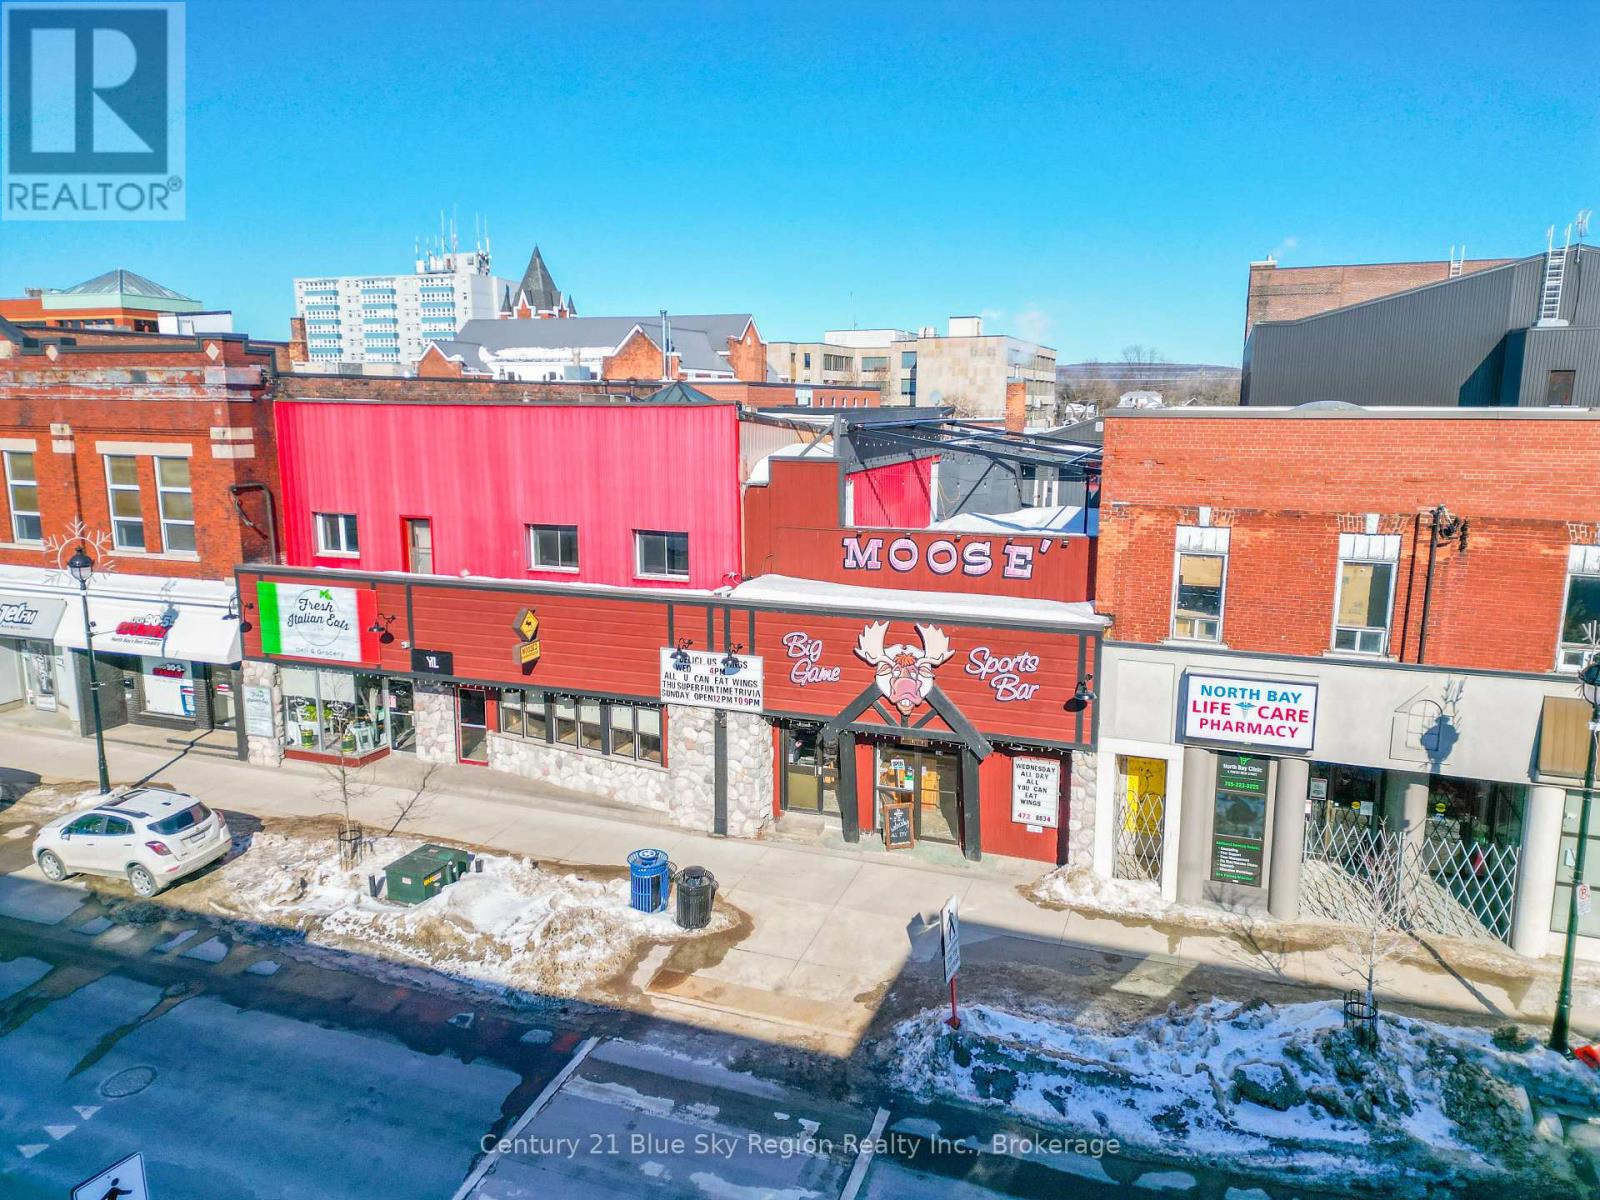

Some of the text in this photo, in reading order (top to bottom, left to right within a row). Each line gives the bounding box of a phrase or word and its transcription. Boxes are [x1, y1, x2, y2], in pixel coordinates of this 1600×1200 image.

[842, 537, 1053, 579] MOOSE'
[298, 598, 334, 612] Fresh
[287, 613, 350, 631] Italian Eats
[317, 649, 345, 658] Grocery
[782, 631, 823, 663] Big
[675, 663, 726, 676] WED 4PM
[965, 646, 1041, 680] Sports
[664, 671, 758, 688] ALL U CAN EAT WINGS
[790, 657, 841, 687] Game
[662, 689, 690, 699] SUNDAY
[663, 680, 761, 698] THU SUPER FUN TIME TRIVIA
[990, 674, 1040, 702] Bar
[1200, 684, 1302, 704] NORTH BAY
[1192, 700, 1309, 723] LIFE CARE
[1199, 718, 1299, 739] PHARMACY
[1015, 763, 1056, 773] WEDNESDAY
[1238, 764, 1247, 772] Bay
[1026, 778, 1039, 786] ALL
[1033, 786, 1048, 794] CAN
[1020, 798, 1041, 807] WINGS
[1018, 812, 1031, 820] 472
